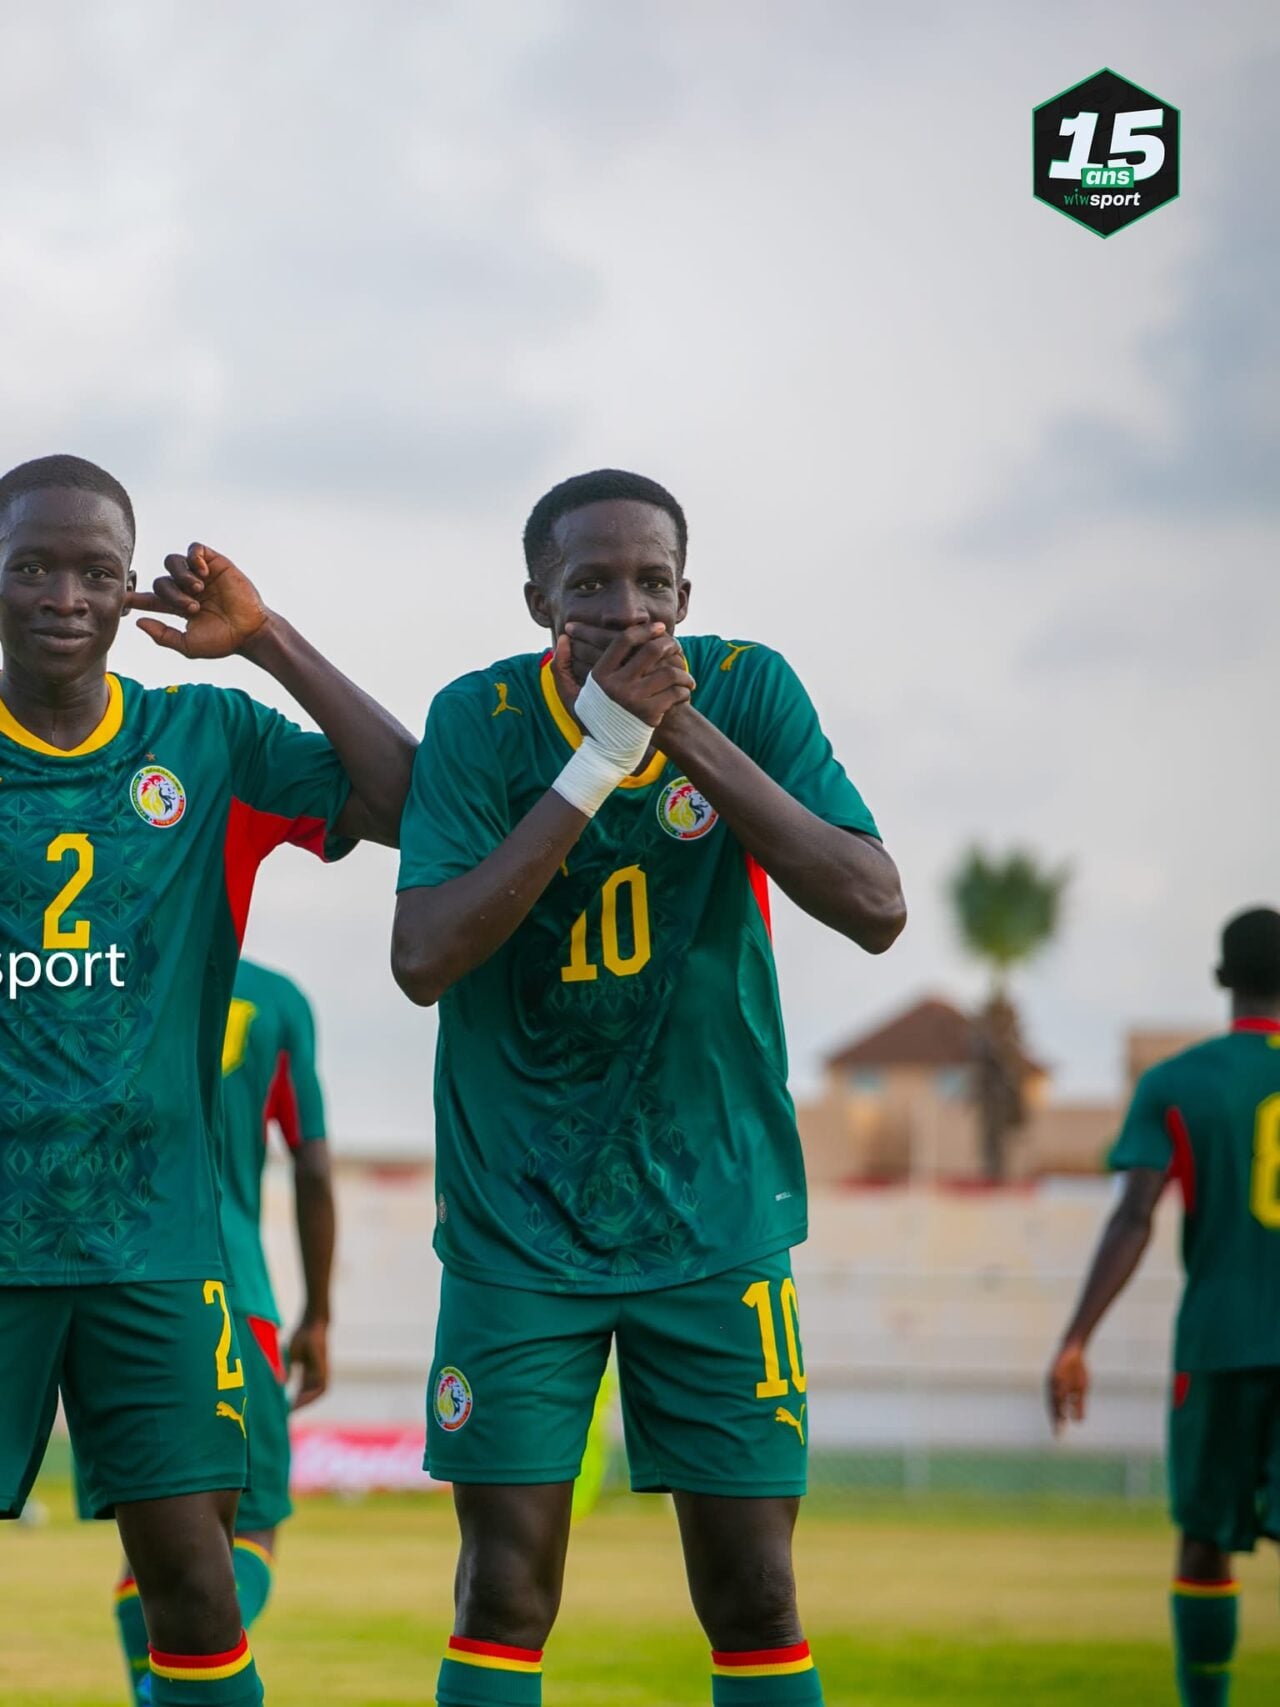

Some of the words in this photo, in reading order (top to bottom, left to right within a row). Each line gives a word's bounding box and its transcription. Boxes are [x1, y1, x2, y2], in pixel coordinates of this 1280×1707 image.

[42, 833, 94, 950] 2
[561, 864, 652, 982] 10
[202, 1279, 244, 1391] 2
[741, 1277, 809, 1399] 10
